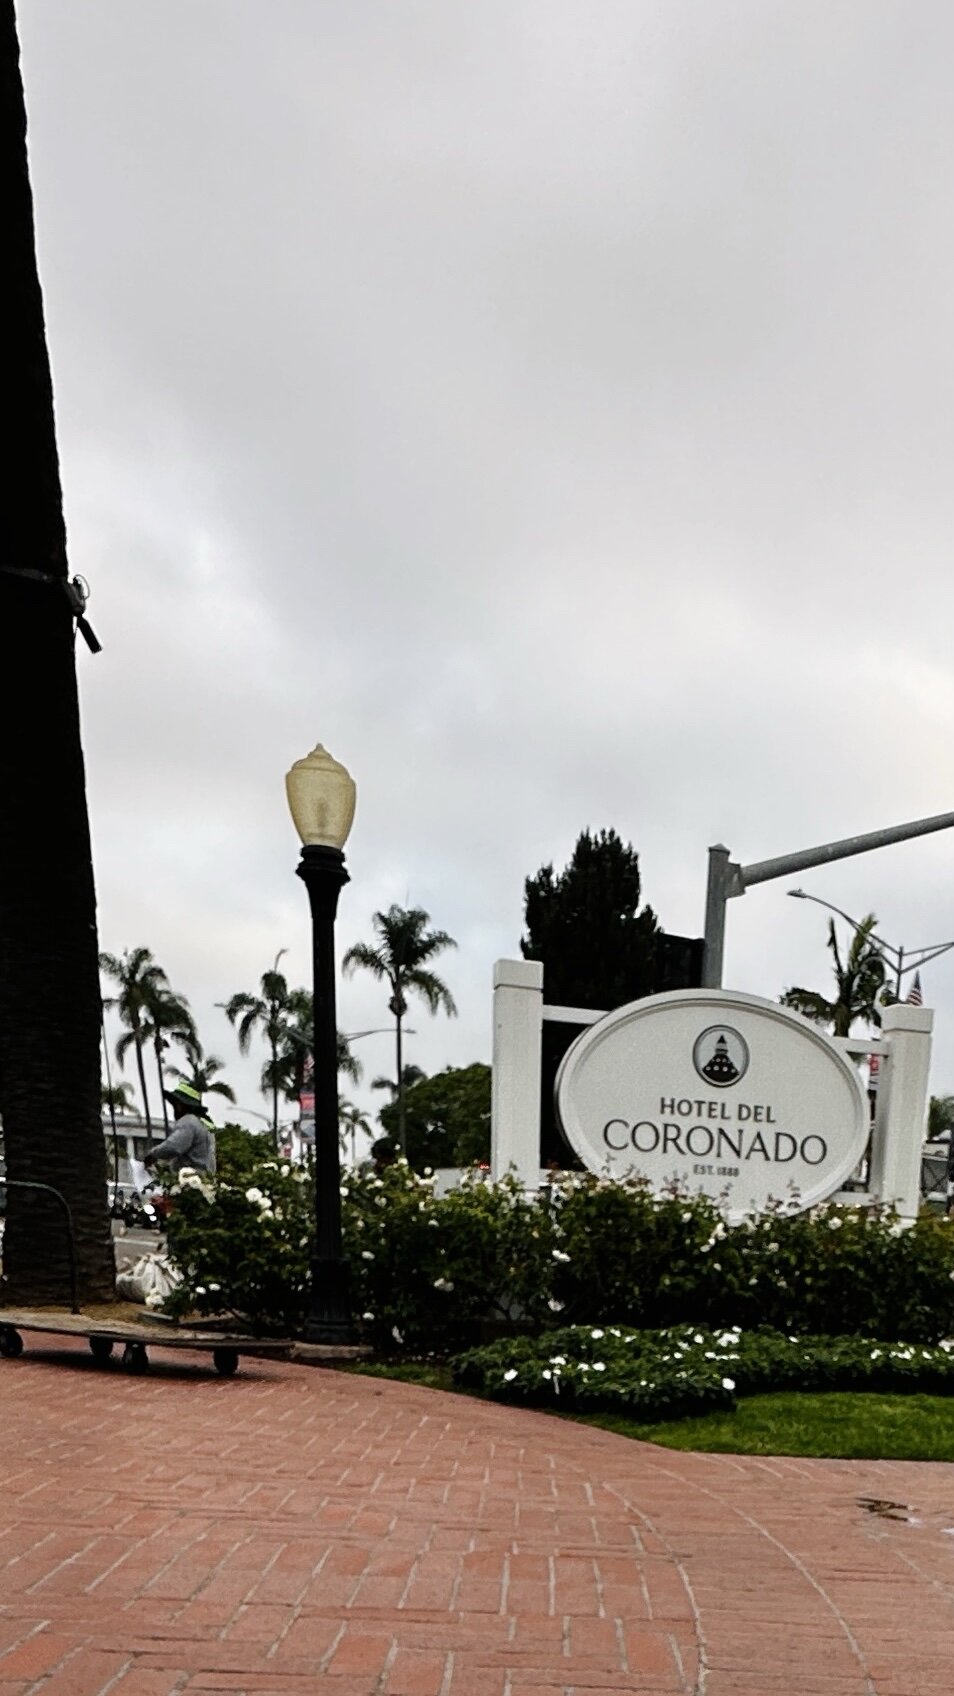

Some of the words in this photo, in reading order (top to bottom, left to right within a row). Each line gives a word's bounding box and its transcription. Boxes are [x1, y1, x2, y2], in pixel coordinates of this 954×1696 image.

[660, 1096, 731, 1120] HOTEL
[738, 1103, 776, 1123] DEL
[603, 1118, 828, 1165] CORONADO
